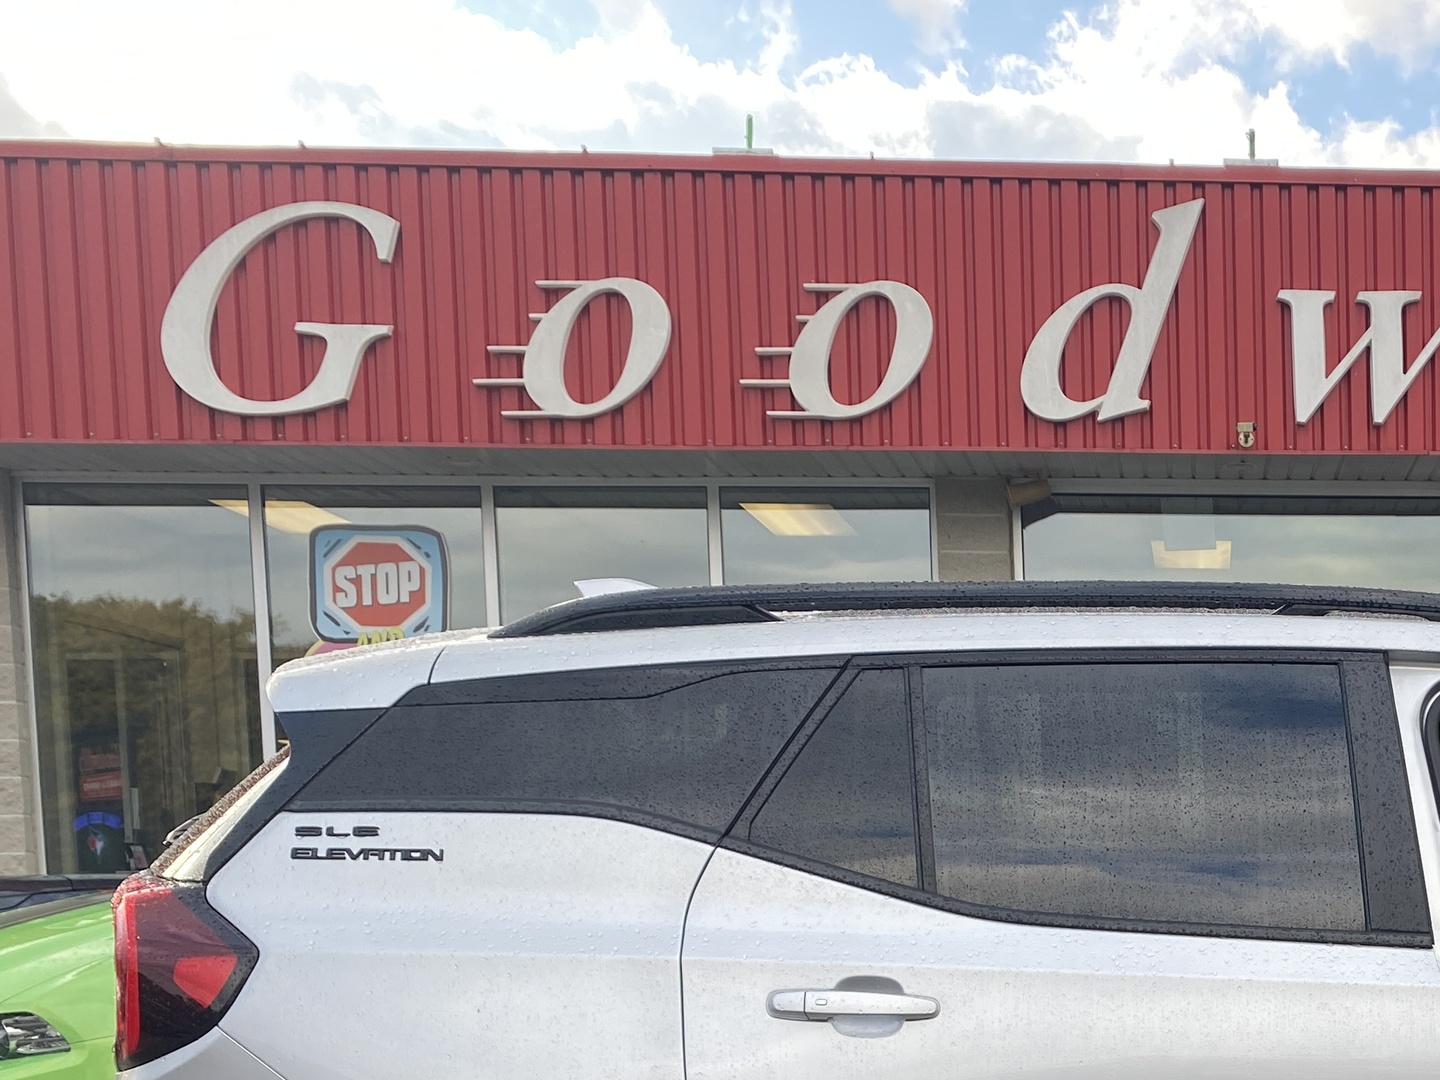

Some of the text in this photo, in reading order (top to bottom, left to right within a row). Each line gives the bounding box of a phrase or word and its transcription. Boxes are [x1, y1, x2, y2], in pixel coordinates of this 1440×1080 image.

[334, 560, 421, 609] STOP
[294, 825, 381, 838] SLE
[290, 846, 445, 863] ELEVATION
